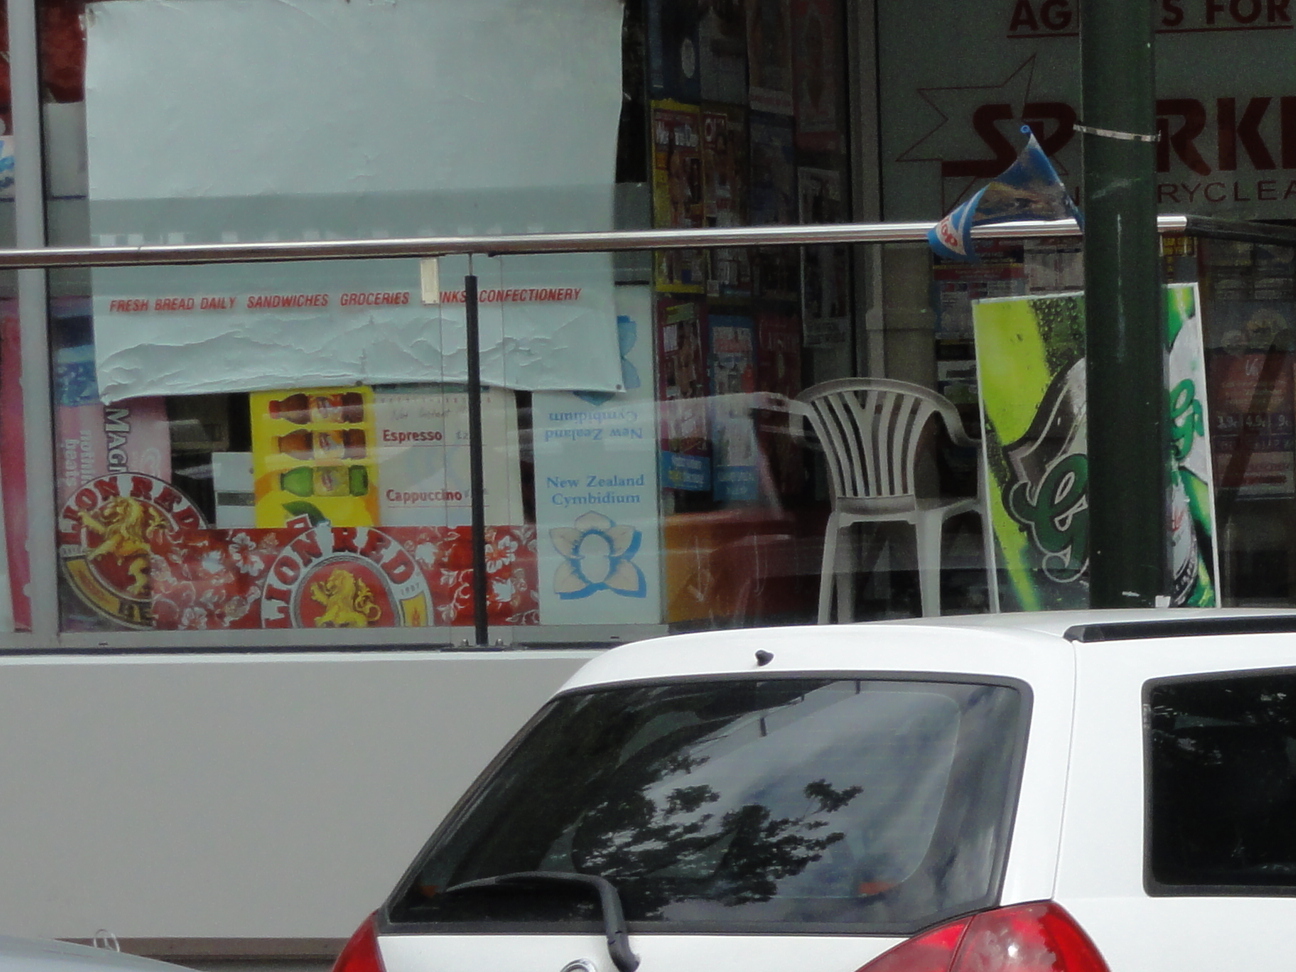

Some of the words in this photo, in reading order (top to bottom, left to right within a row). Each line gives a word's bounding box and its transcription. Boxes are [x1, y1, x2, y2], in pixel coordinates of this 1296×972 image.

[1205, 0, 1291, 24] FOR
[109, 299, 149, 312] FRESH
[154, 298, 195, 311] BREAD
[200, 297, 237, 310] DAILY
[246, 293, 329, 309] SANDWICHES
[340, 291, 410, 306] GROCERIES
[439, 289, 467, 304] INKS
[479, 287, 583, 303] CONFECTIONERY
[382, 429, 442, 443] Espresso
[547, 476, 578, 488] New
[586, 474, 645, 488] Zealand
[386, 489, 462, 504] Cappuccino
[551, 492, 640, 508] Cymbidium
